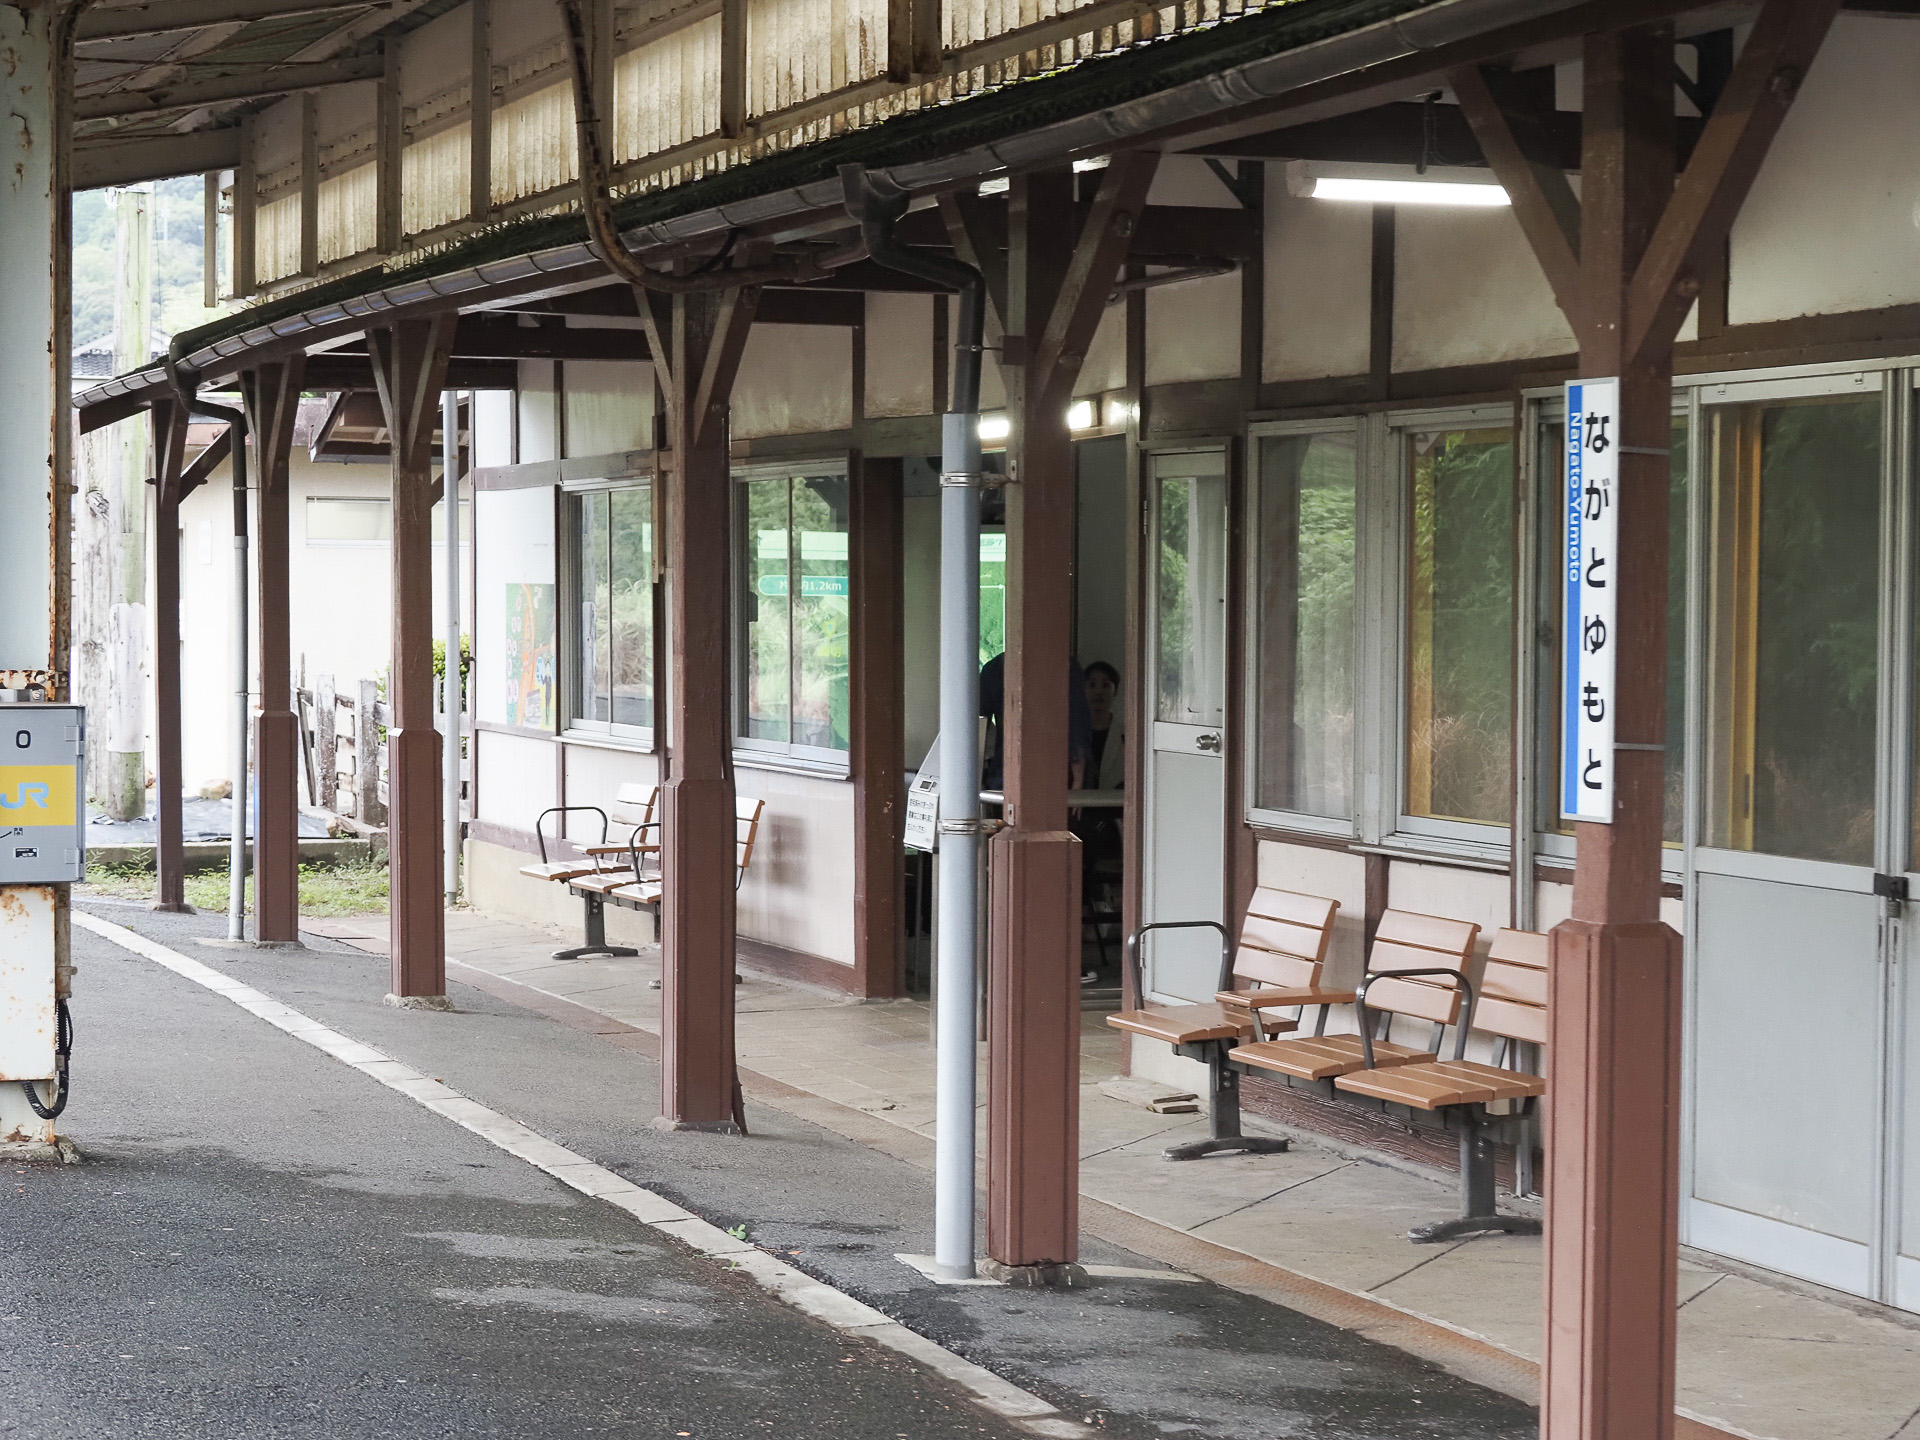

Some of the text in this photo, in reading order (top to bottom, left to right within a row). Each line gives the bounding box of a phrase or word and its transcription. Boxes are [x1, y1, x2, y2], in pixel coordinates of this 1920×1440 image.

[1568, 412, 1582, 582] Nagato-Yumoto
[1583, 411, 1610, 790] ながとゆもと
[0, 782, 49, 809] JR
